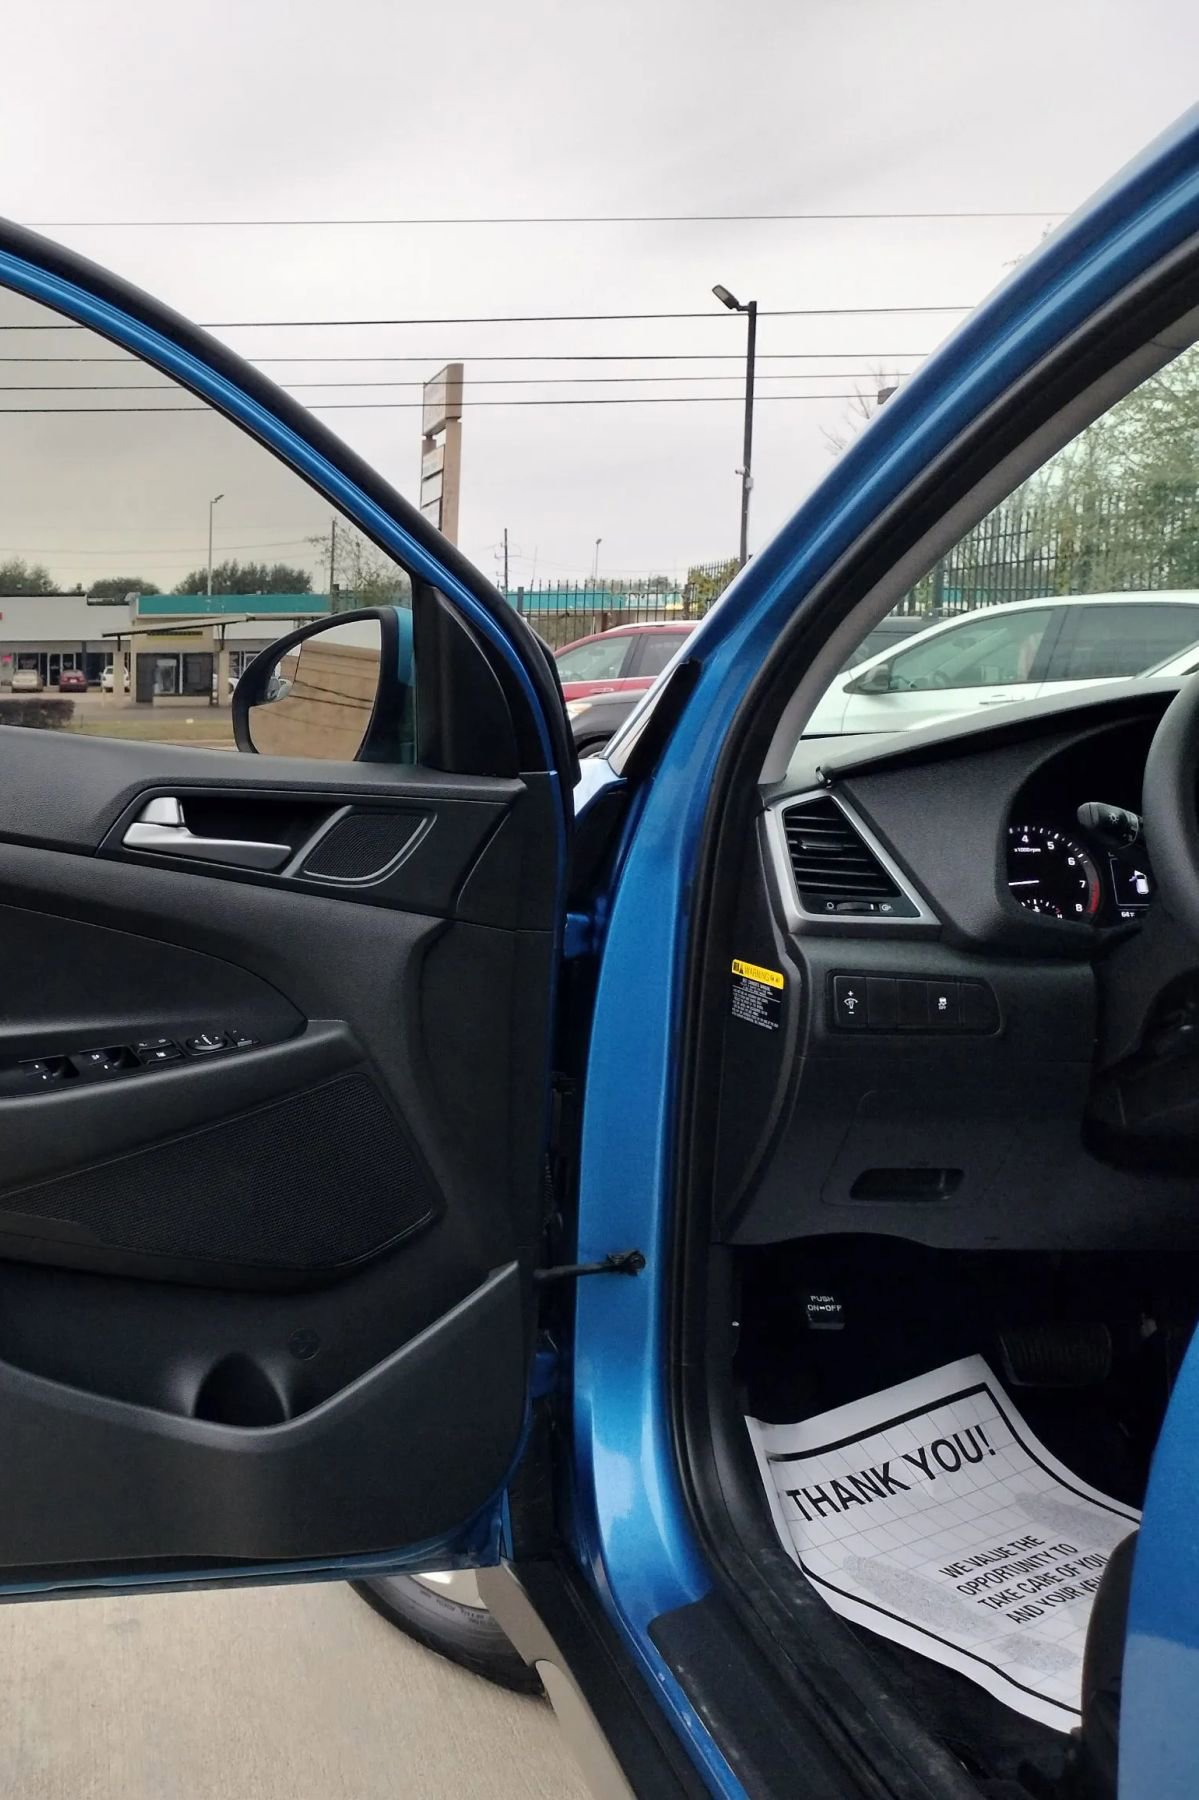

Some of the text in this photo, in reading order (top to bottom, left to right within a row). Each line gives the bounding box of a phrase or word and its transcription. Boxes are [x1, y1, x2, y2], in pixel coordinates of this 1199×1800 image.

[1021, 834, 1029, 843] 4
[1047, 841, 1055, 850] 5
[1067, 857, 1076, 866] 6
[1079, 880, 1086, 888] 7
[1075, 903, 1083, 912] 8
[785, 1424, 997, 1522] THANK YOU!
[938, 1535, 1046, 1579] WE VALUE THE
[956, 1543, 1079, 1596] OPPORTUNITY TO
[977, 1588, 1026, 1610] TAKE
[1017, 1572, 1065, 1594] CARE
[1055, 1563, 1083, 1578] OF
[1005, 1604, 1046, 1625] AND
[1035, 1586, 1085, 1608] YOUR
